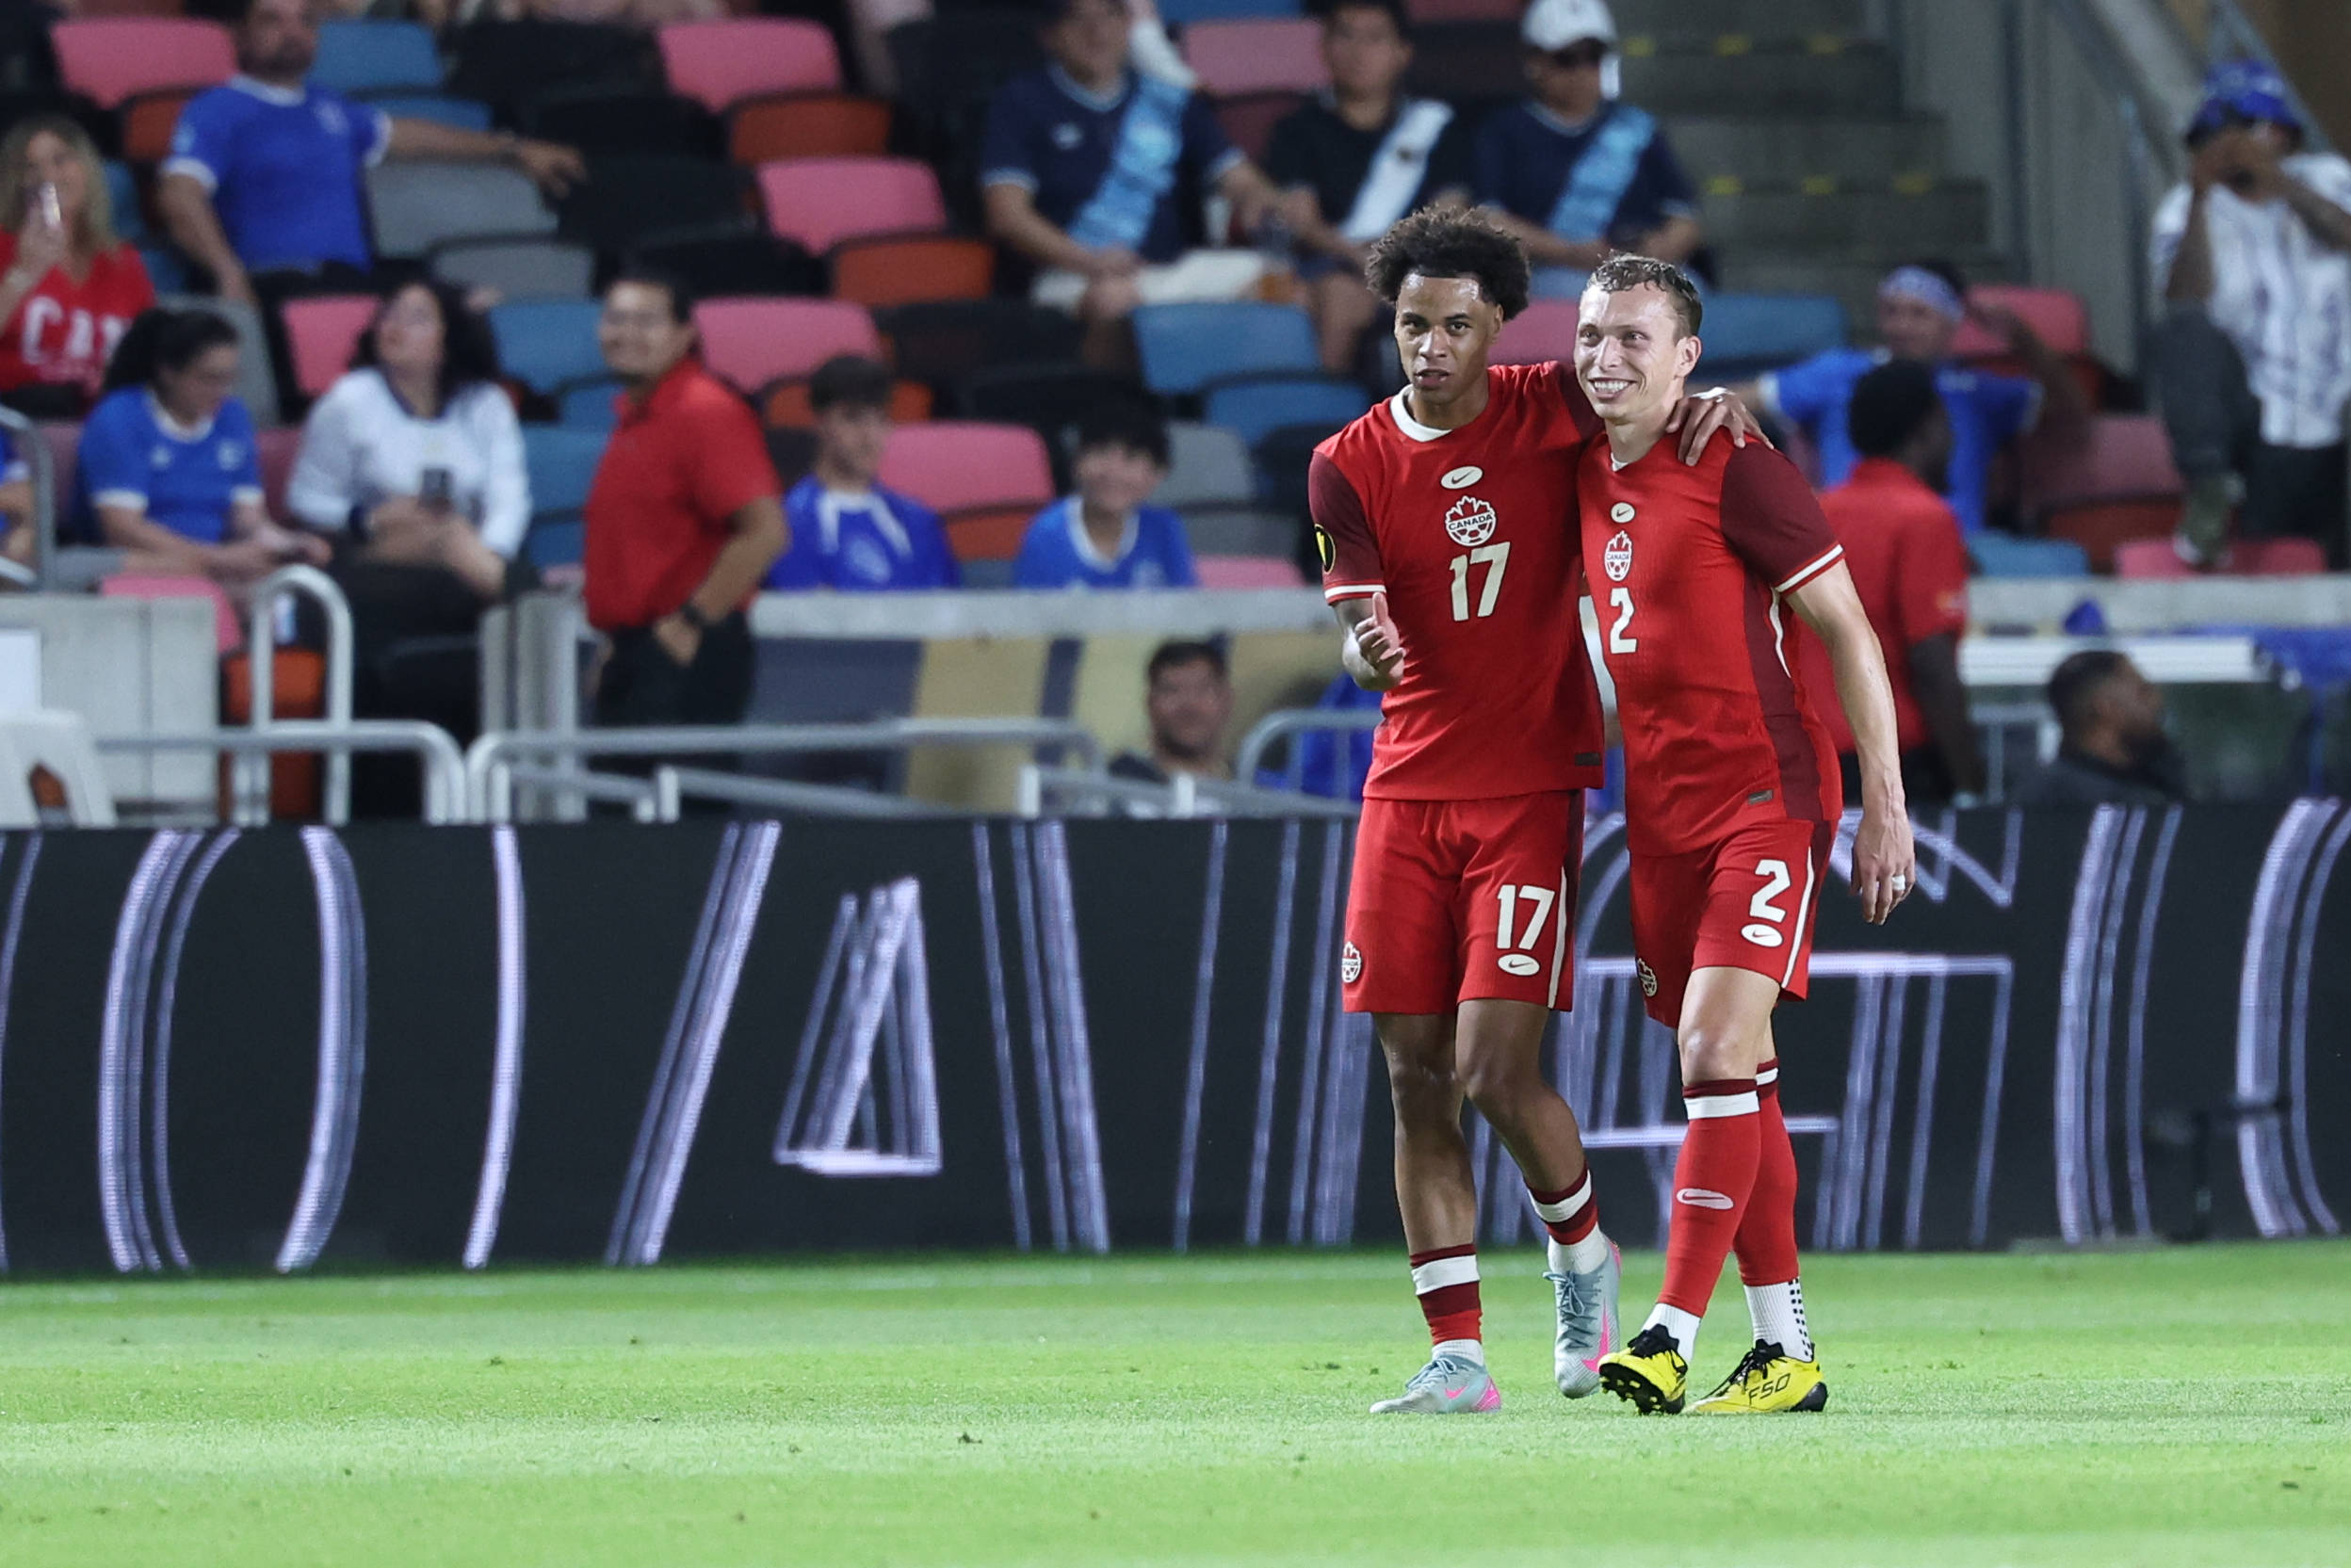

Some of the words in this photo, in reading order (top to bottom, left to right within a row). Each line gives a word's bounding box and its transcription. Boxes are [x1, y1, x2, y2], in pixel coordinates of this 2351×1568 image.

[1449, 514, 1493, 530] CANADA
[1450, 542, 1511, 622] 17
[1610, 587, 1638, 655] 2
[1497, 884, 1556, 950] 17
[1749, 859, 1791, 923] 2
